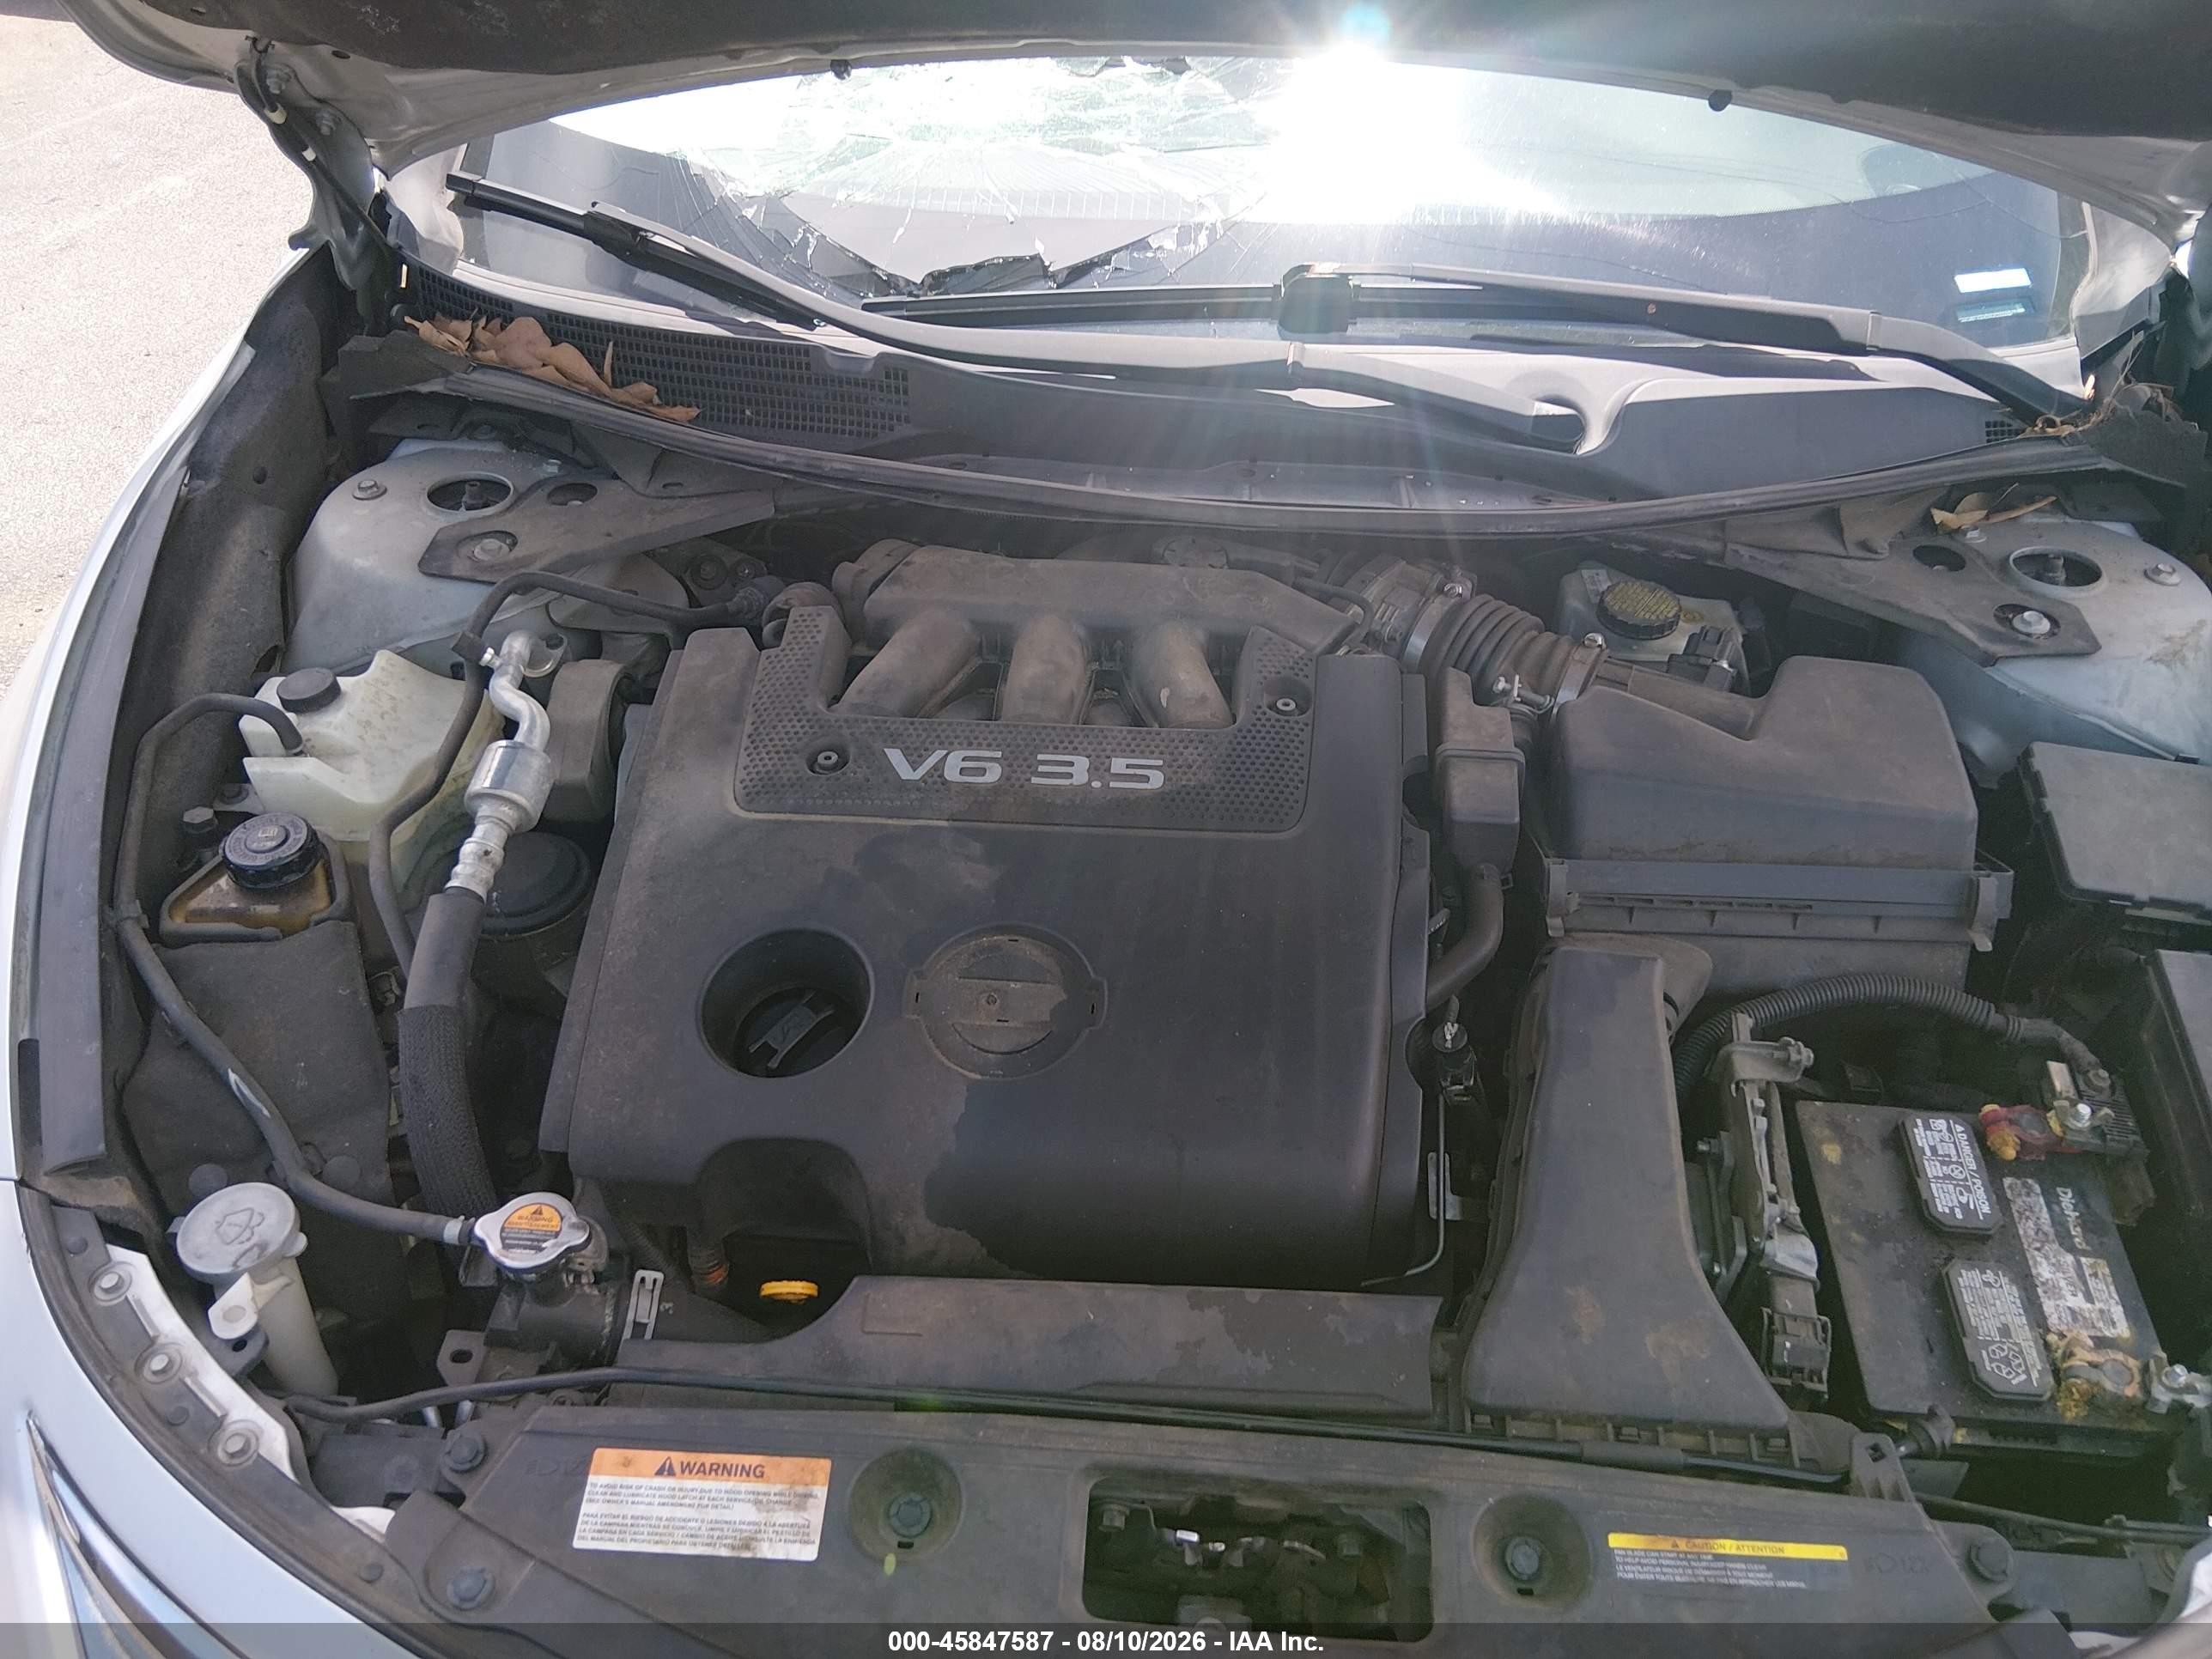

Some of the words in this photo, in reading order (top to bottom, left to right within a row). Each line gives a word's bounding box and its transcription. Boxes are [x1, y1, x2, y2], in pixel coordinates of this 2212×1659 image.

[883, 748, 1003, 783] V6
[1030, 754, 1165, 790] 3.5
[1957, 1133, 1978, 1170] DANGER
[1971, 1179, 1991, 1213] POISON
[680, 1462, 765, 1479] WARNING
[1686, 1540, 1726, 1551] CAUTION
[1736, 1544, 1785, 1554] ATTENTION
